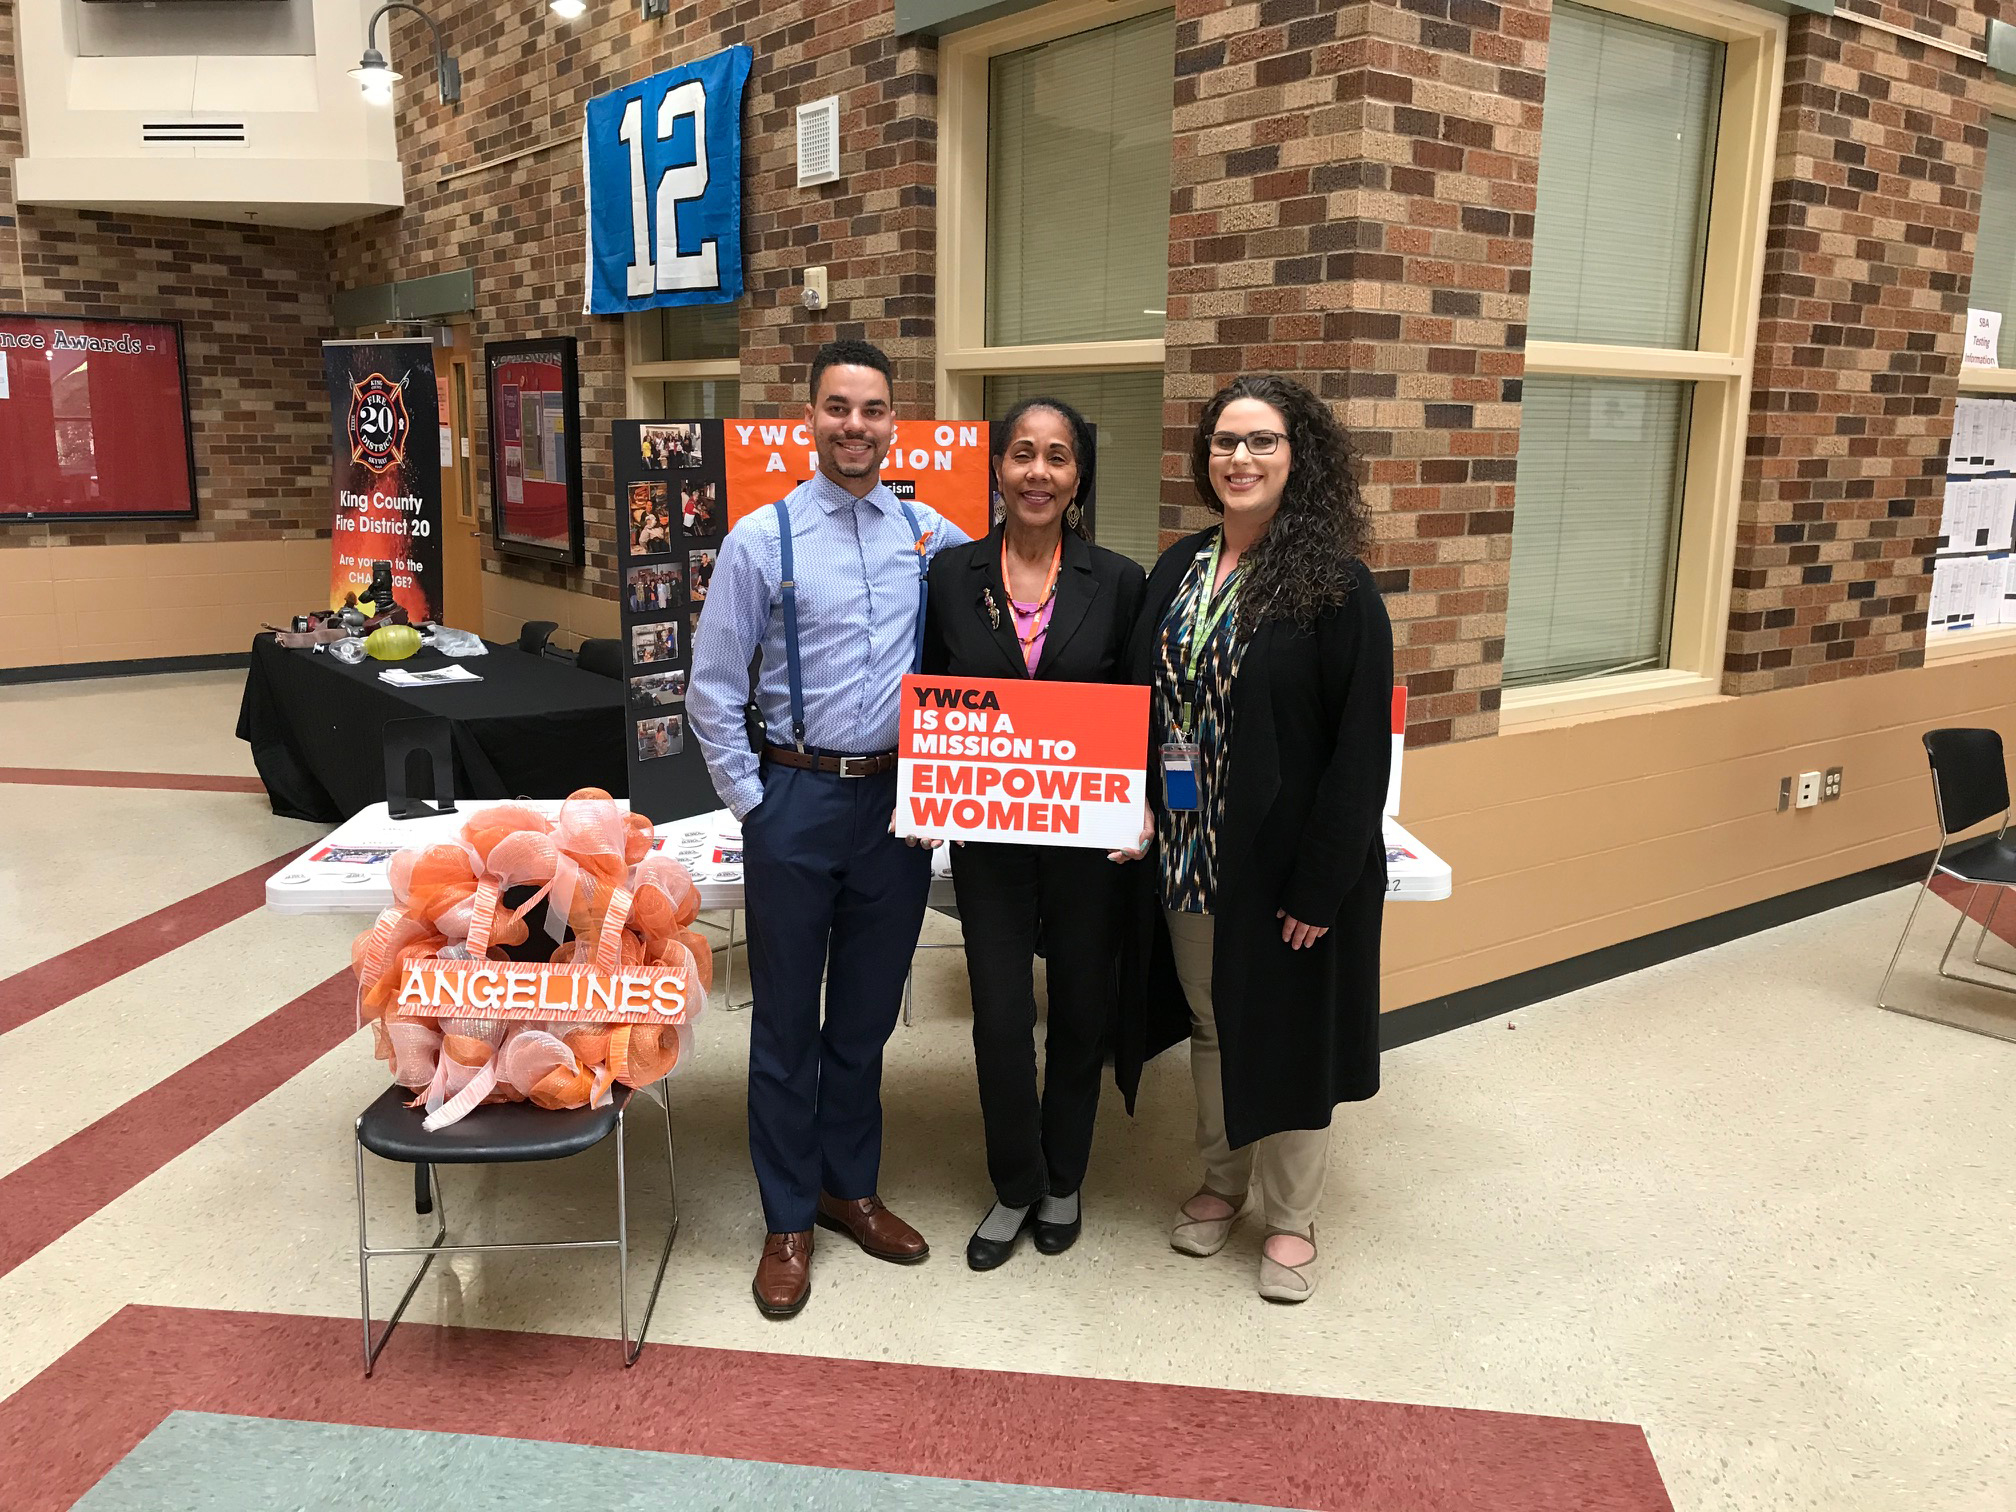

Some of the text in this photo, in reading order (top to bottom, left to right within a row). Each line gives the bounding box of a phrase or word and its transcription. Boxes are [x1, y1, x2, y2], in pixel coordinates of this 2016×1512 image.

[619, 78, 721, 299] 12
[54, 330, 143, 354] Awards
[1974, 336, 1991, 349] Testing
[1965, 353, 1996, 365] Information
[367, 395, 387, 406] FIRE
[360, 406, 393, 434] 20
[361, 433, 393, 452] DISTRICT
[934, 426, 978, 447] ON
[766, 452, 787, 472] A
[340, 490, 423, 515] King County
[336, 514, 430, 537] Fire District 20
[339, 554, 355, 566] Are
[395, 557, 405, 570] to
[407, 559, 423, 572] the
[913, 687, 1000, 711] YWCA
[913, 709, 1014, 734] IS ON A
[911, 733, 1076, 761] MISSION TO
[911, 764, 1131, 804] EMPOWER
[909, 796, 1080, 834] WOMEN
[397, 966, 687, 1016] ANGELINES
